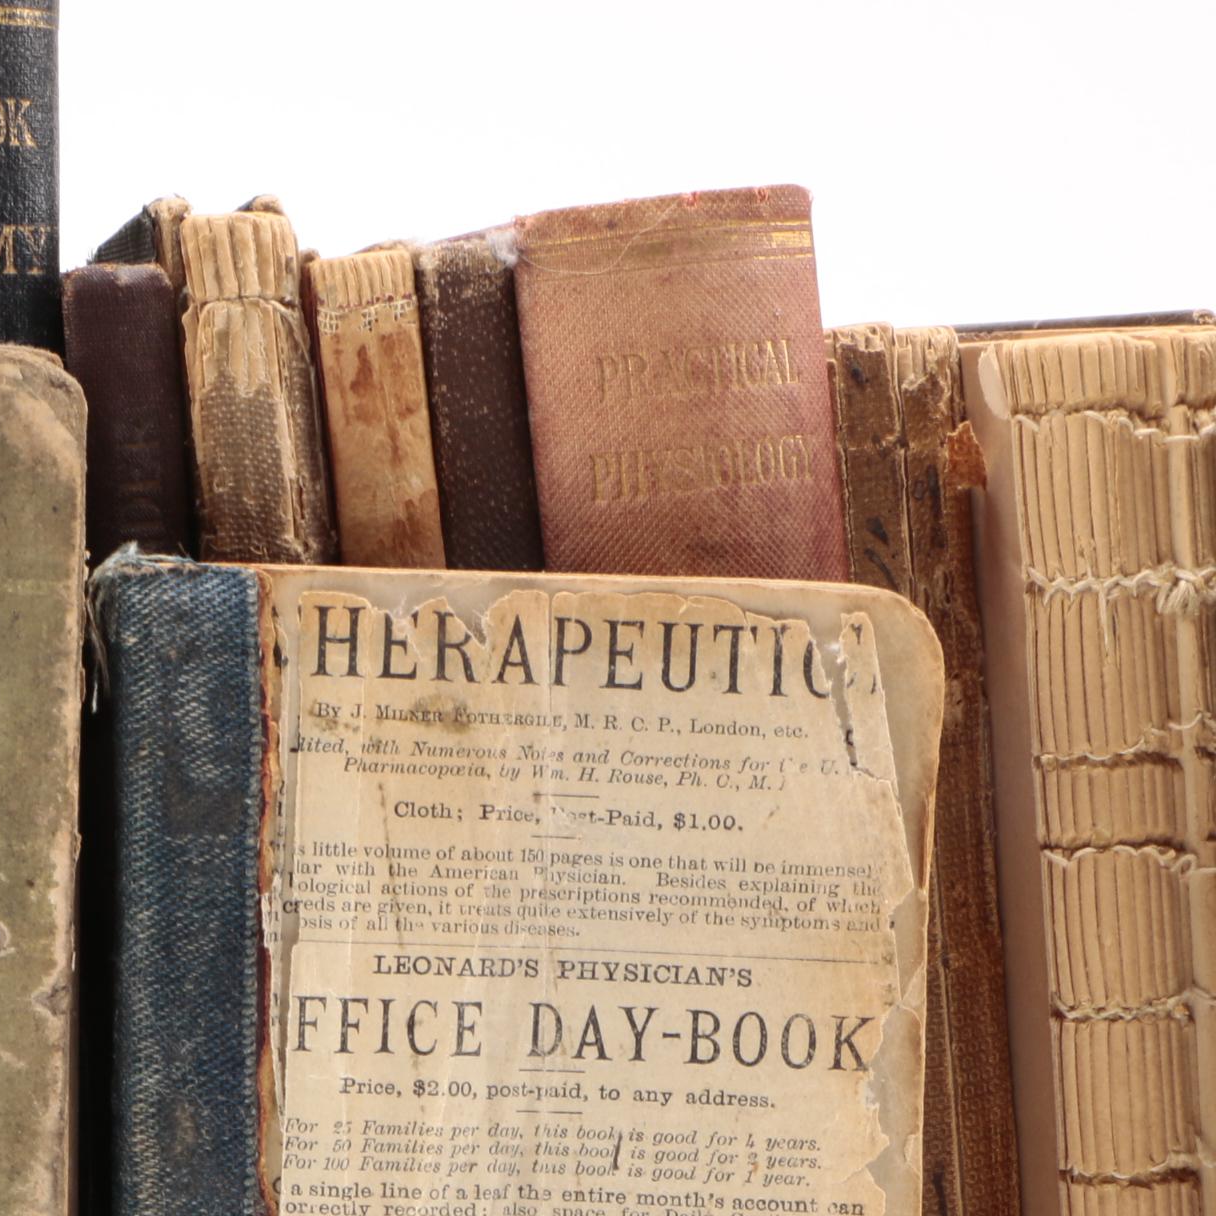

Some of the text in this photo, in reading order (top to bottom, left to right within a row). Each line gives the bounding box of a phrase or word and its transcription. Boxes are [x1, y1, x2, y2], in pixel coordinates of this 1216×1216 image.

[574, 714, 808, 739] M. London, etc.
[573, 750, 770, 773] and Corrections for
[579, 768, 707, 788] H. Rouse, Ph.
[394, 801, 743, 832] Cloth; Price, $1.00.
[313, 842, 746, 873] little volume of about 150 pages is one that will
[336, 862, 840, 897] with the American Besides explaining
[381, 883, 816, 913] actions of prescriptions of
[566, 907, 698, 927] extensively of
[373, 955, 753, 988] LEONARD'S PHYSICIAN'S
[527, 1000, 876, 1073] DAY-BOOK
[339, 1077, 776, 1109] Price, $2.00, to any address.
[284, 1118, 821, 1152] For per day, good for years.
[284, 1137, 822, 1170] For good years.
[283, 1154, 811, 1188] For good year.
[309, 1182, 818, 1213] single line entire month's account
